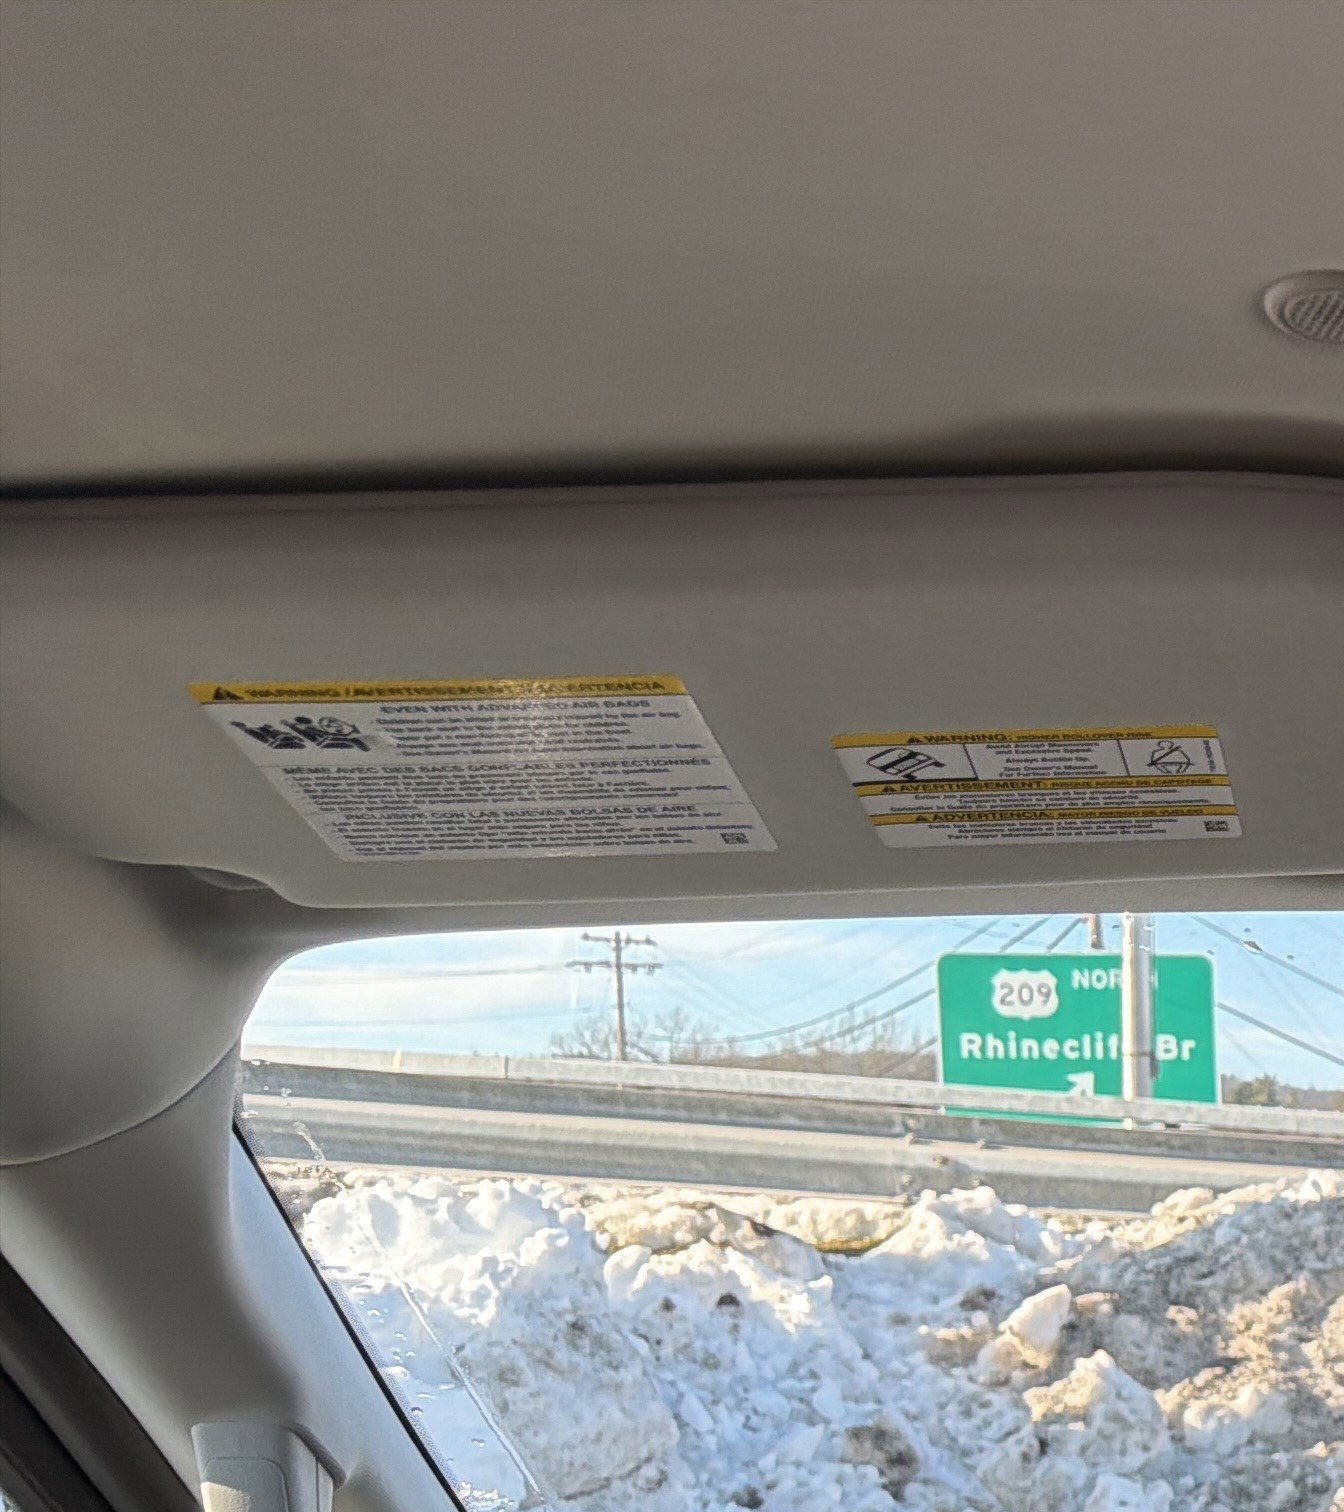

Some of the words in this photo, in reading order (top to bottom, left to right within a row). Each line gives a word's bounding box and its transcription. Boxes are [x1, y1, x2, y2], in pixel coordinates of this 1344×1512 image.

[999, 982, 1053, 1008] 209
[958, 1030, 1120, 1061] Rhineclif
[1155, 1033, 1197, 1061] Br
